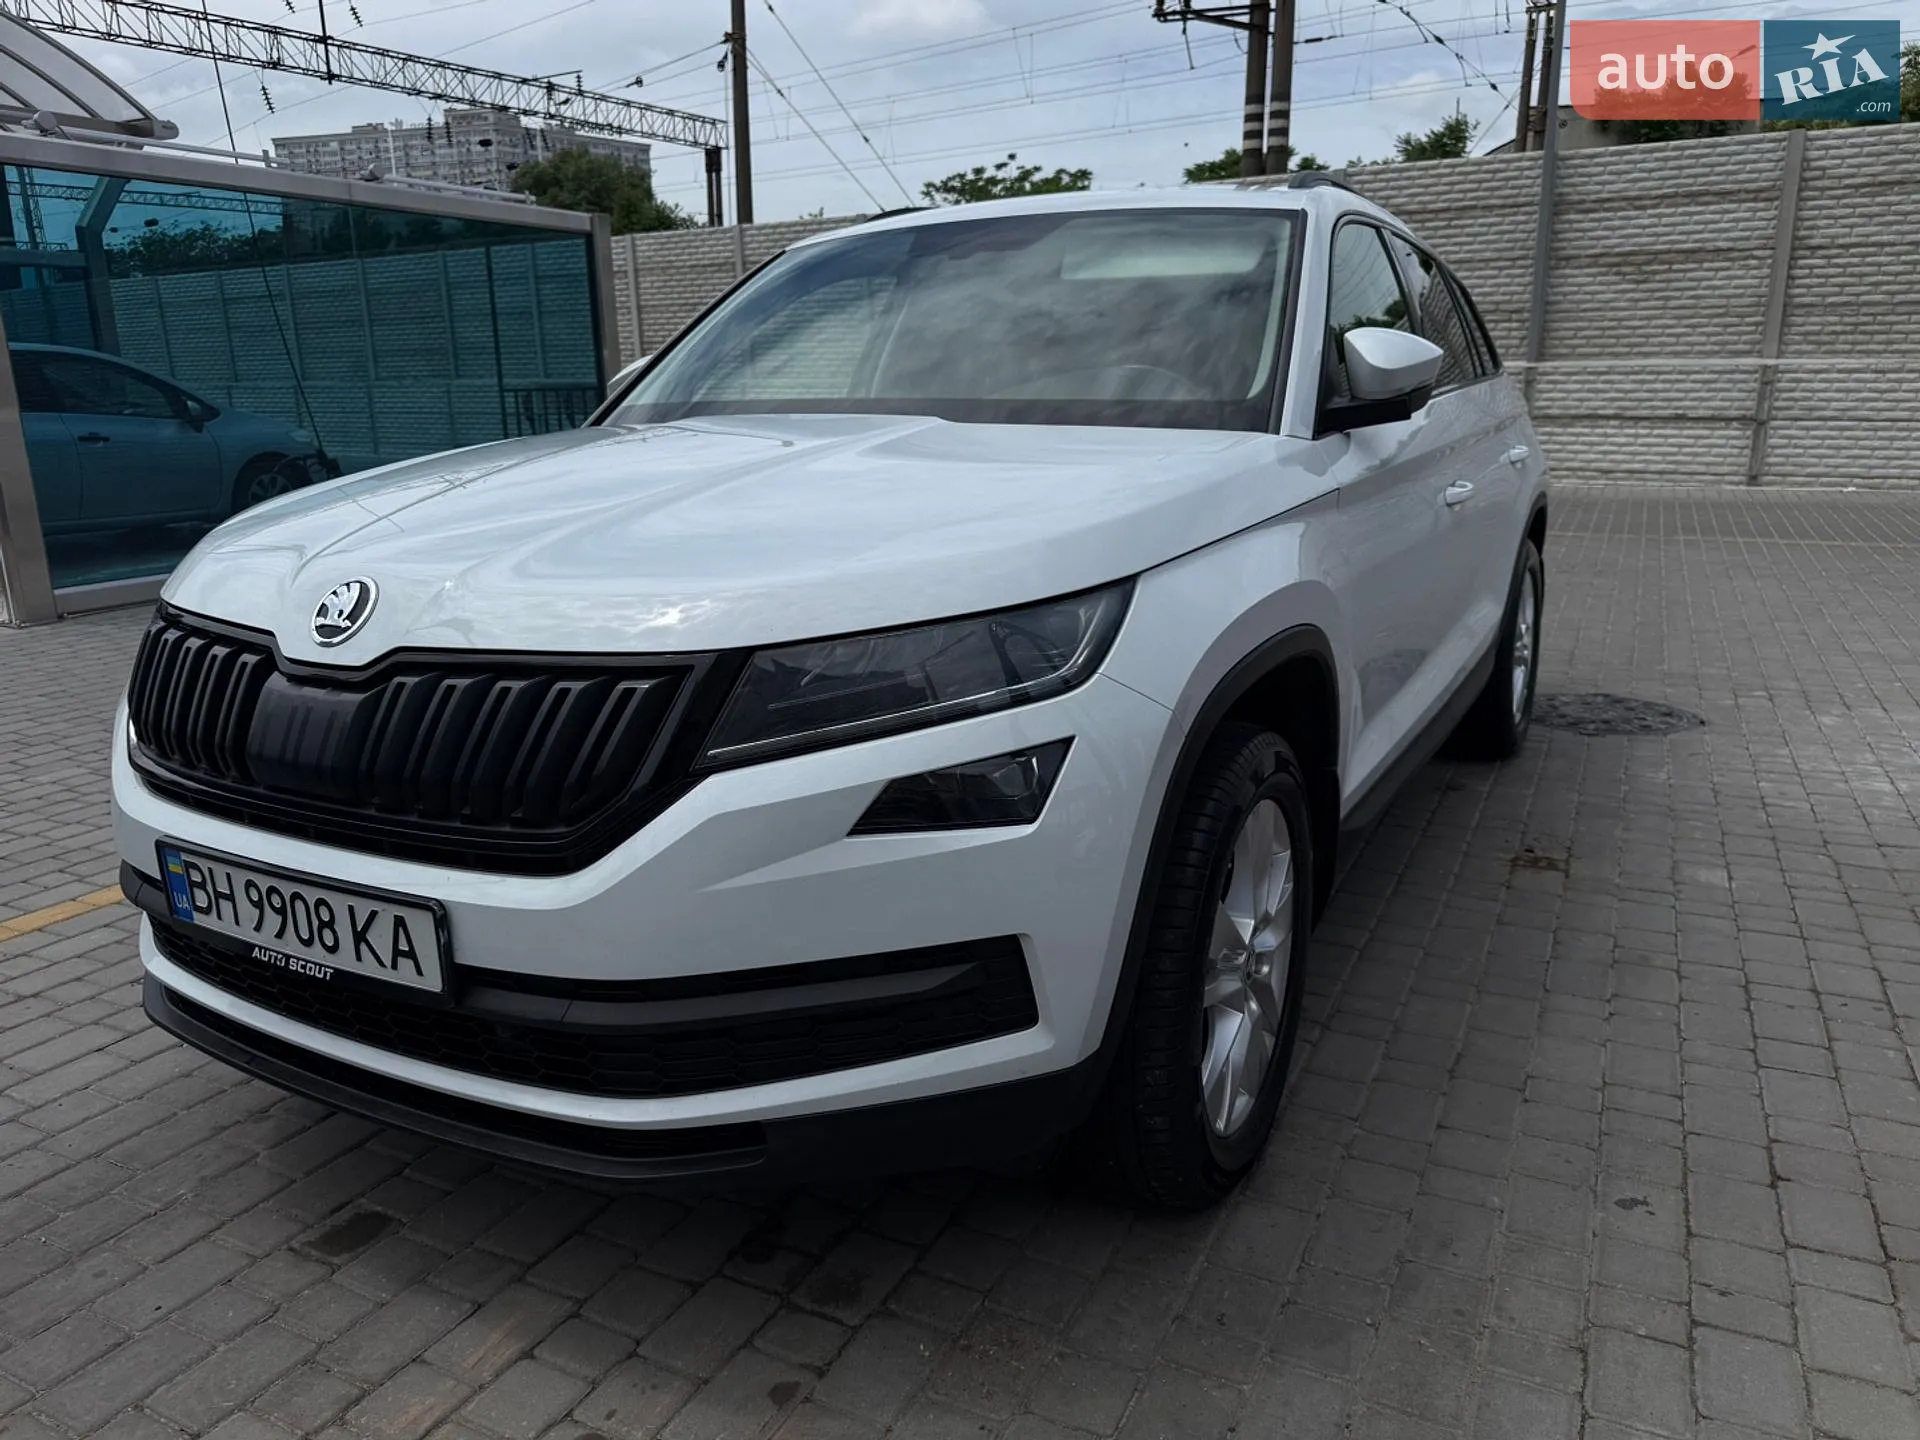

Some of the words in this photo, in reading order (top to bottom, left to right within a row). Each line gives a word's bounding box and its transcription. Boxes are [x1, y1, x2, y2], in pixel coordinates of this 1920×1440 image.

[173, 891, 190, 910] UA
[183, 861, 241, 927] BH
[243, 878, 340, 954] 9908
[347, 903, 425, 978] KA
[252, 946, 286, 967] AUTO
[288, 958, 334, 981] SCOUT
